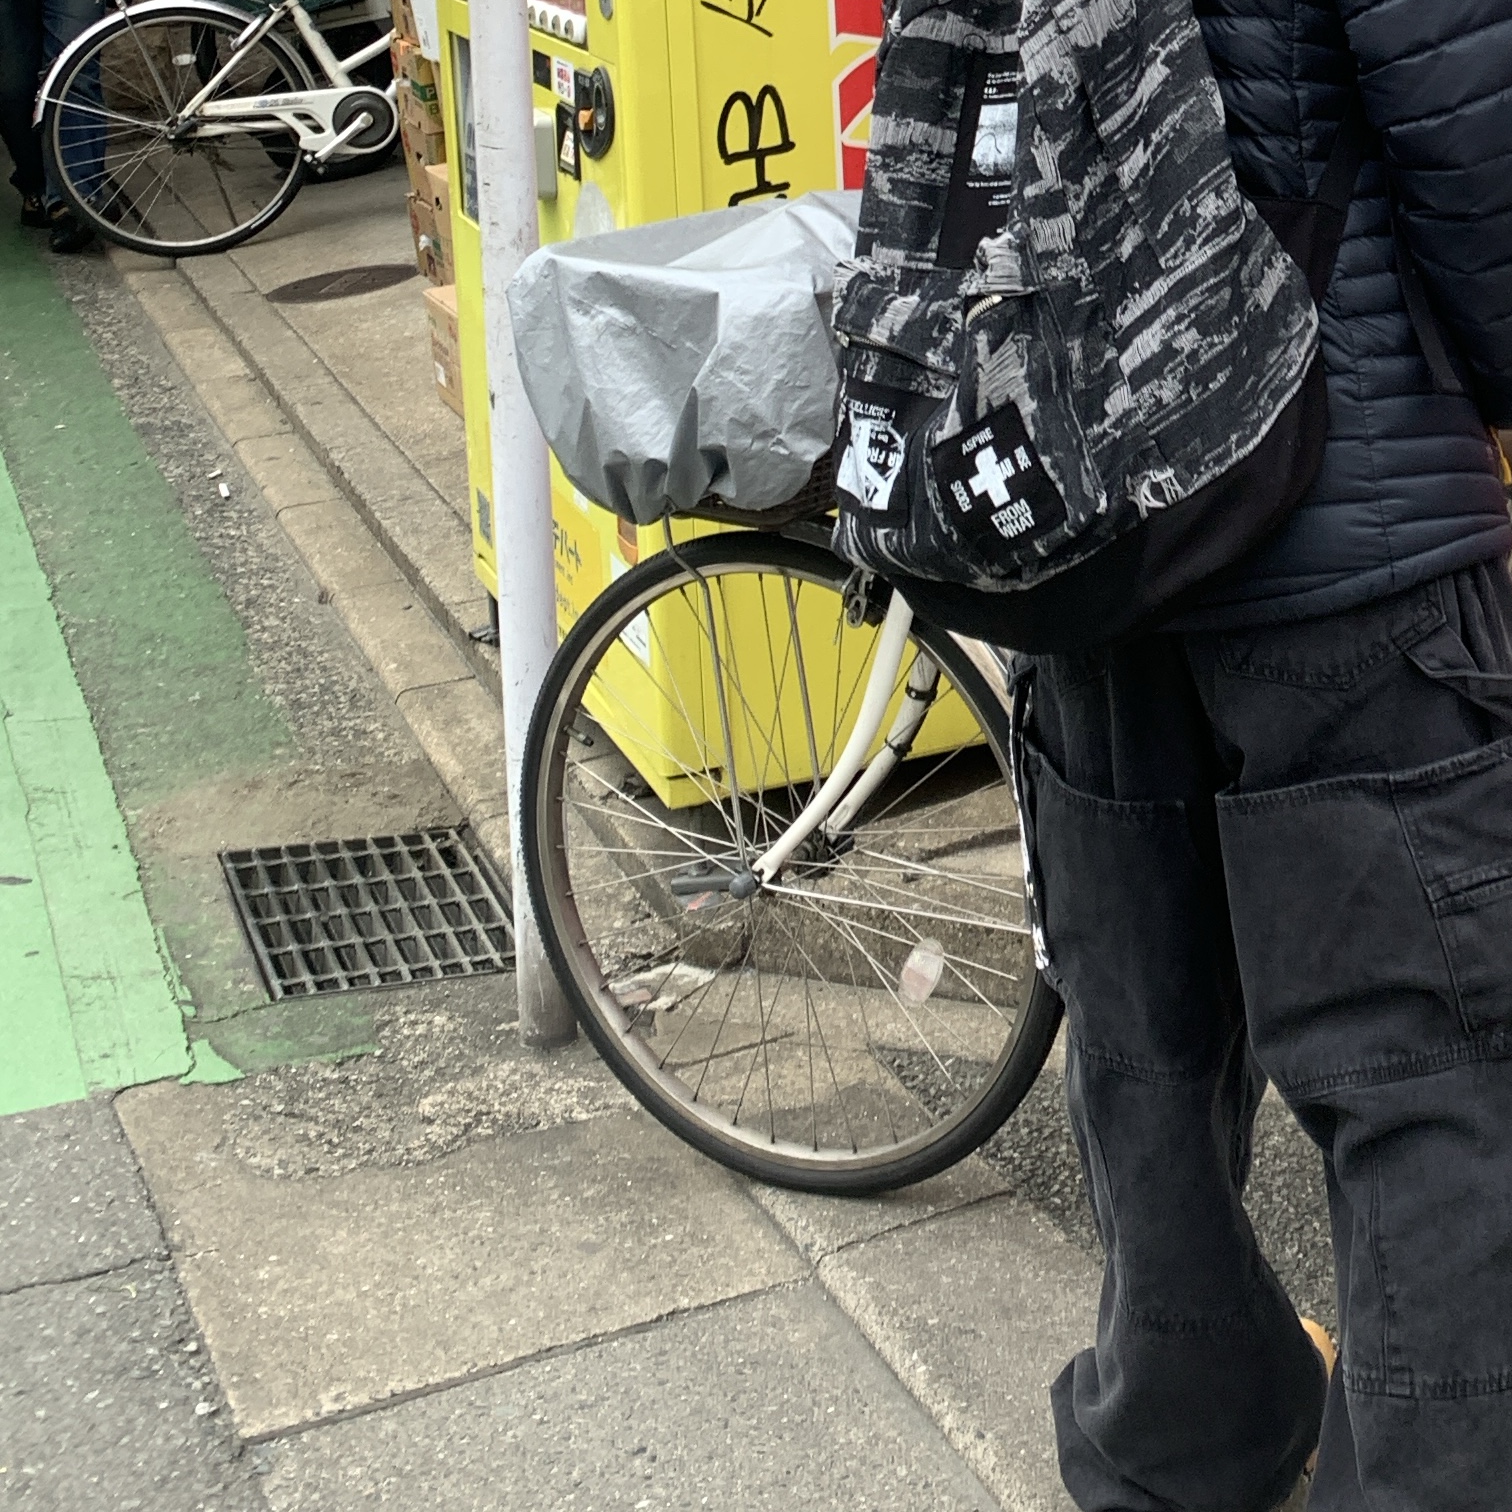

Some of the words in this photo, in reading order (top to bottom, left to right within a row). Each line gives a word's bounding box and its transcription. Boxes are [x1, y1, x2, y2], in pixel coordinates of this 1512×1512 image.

[961, 426, 995, 456] ASPIRE
[990, 498, 1032, 527] FROM
[1000, 513, 1036, 541] WHAT
